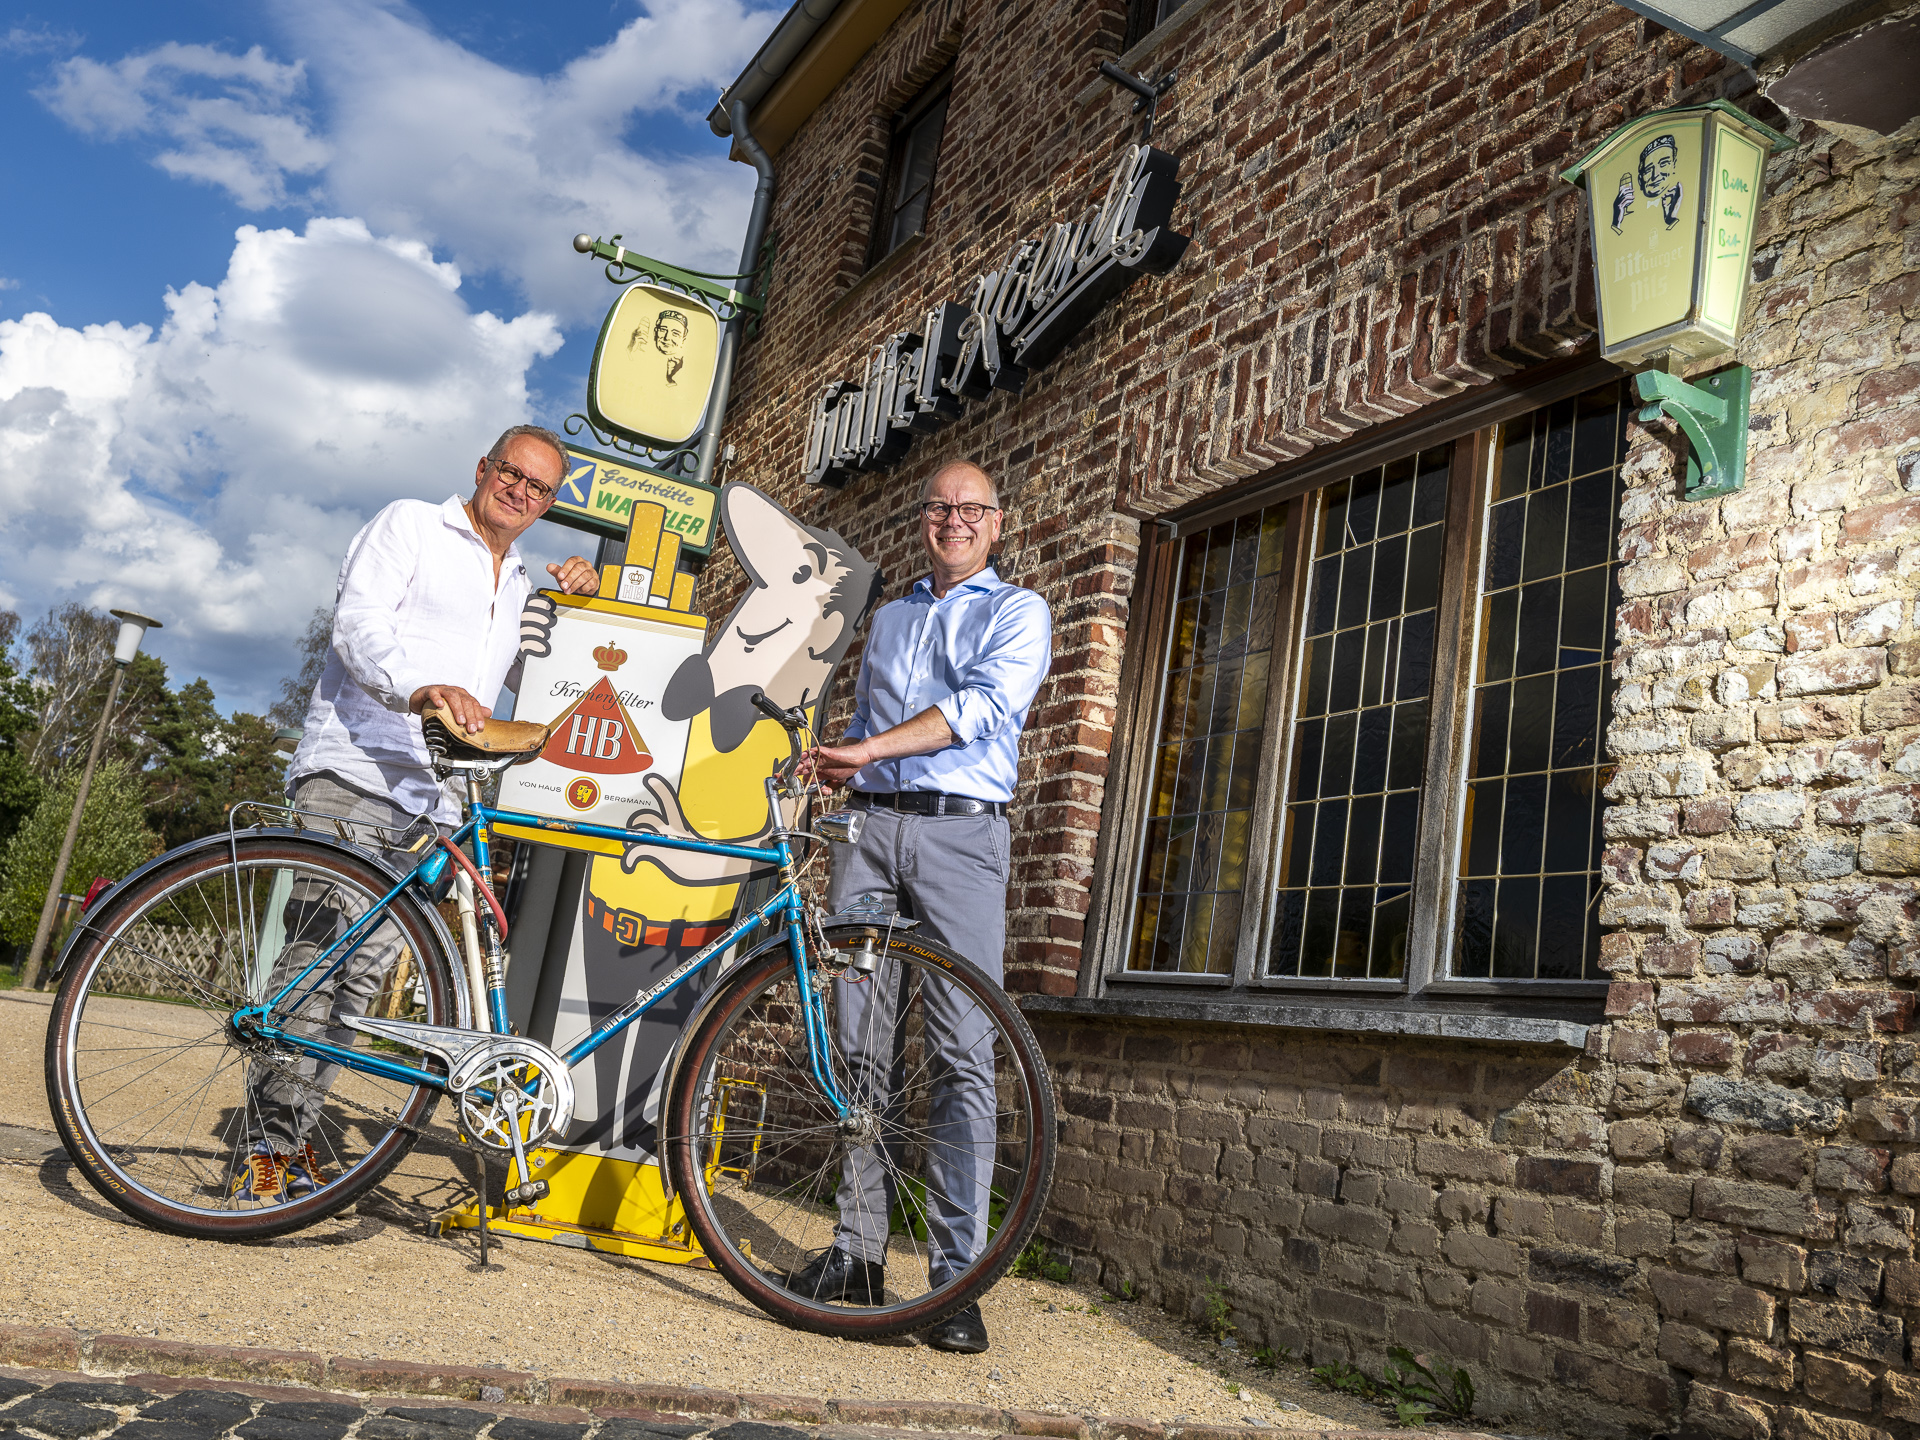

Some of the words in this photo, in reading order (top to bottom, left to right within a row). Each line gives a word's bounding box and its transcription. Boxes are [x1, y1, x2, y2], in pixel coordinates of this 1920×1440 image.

[1722, 168, 1748, 193] Bitte
[1723, 205, 1742, 219] ein
[1718, 228, 1741, 247] Bit
[1613, 245, 1684, 283] Bitburger
[599, 468, 695, 506] Gaststätte
[622, 584, 645, 601] HB
[549, 680, 655, 711] Kronenfilter
[564, 712, 625, 761] HB
[518, 780, 538, 790] VON
[538, 784, 562, 793] HAUS
[603, 794, 652, 807] BERGMANN
[908, 944, 955, 969] TOURING
[80, 1147, 99, 1168] TOP
